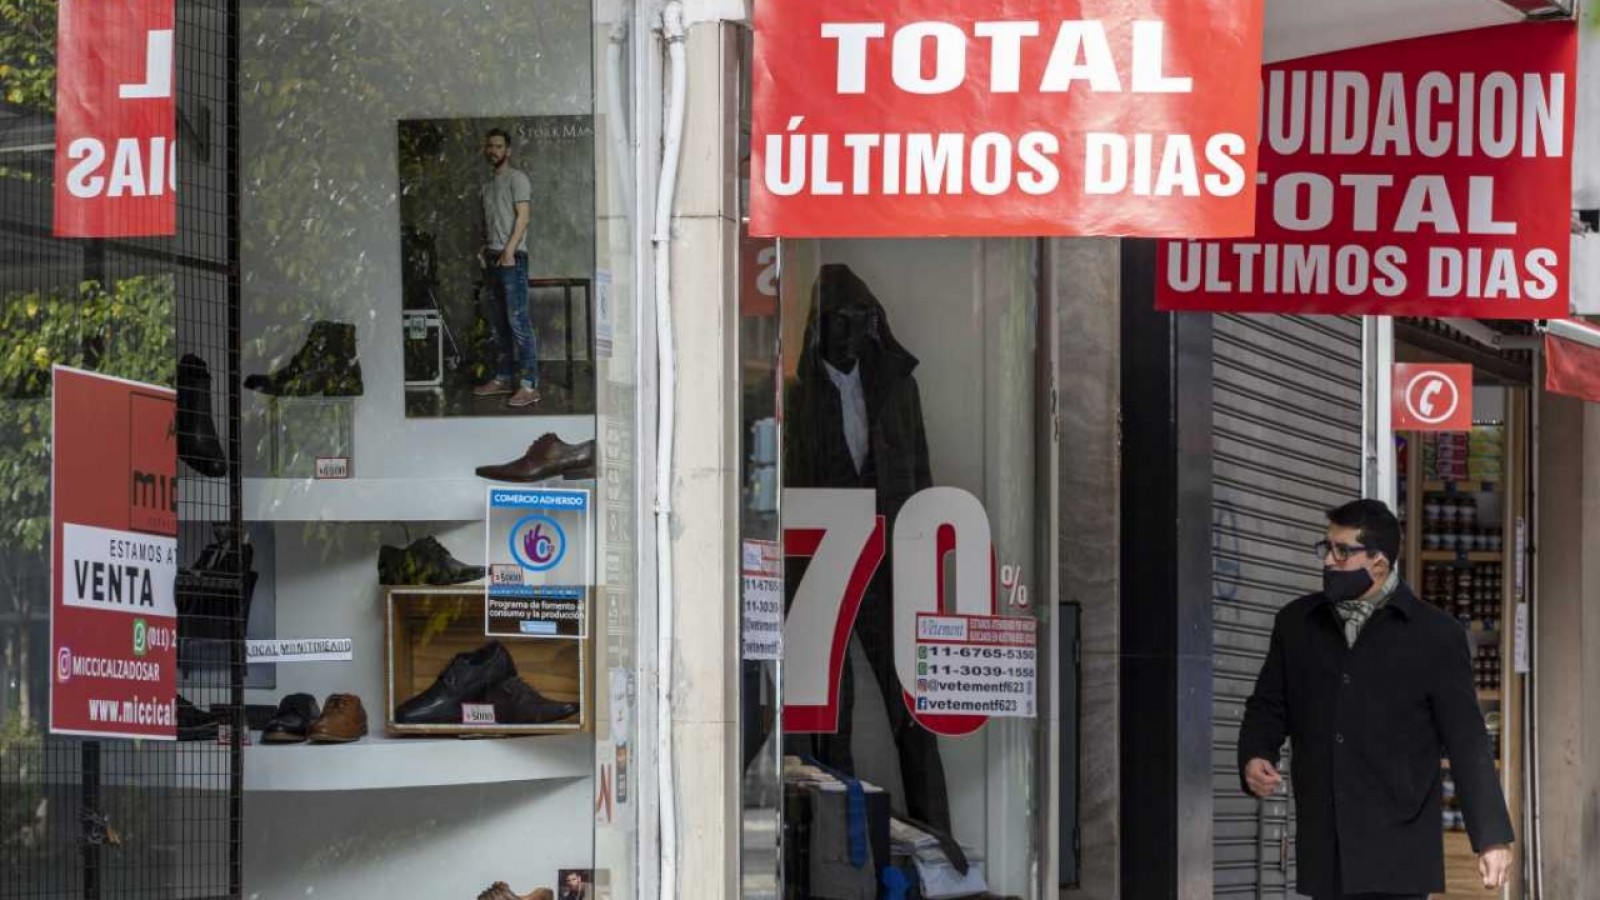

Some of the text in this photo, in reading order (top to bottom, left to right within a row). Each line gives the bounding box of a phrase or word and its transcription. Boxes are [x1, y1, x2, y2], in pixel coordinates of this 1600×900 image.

[820, 20, 1193, 95] TOTAL
[1260, 70, 1565, 159] UIDACION
[764, 115, 1246, 198] ÚLTIMOS DIAS
[1427, 247, 1559, 300] DIAS
[494, 493, 584, 506] COMERCIO ADHERIDO
[110, 539, 162, 564] ESTAMOS
[74, 559, 154, 607] VENTA
[489, 600, 528, 611] Programa
[530, 602, 540, 610] de
[541, 602, 576, 611] fomento
[489, 610, 585, 621] consumo y la producción
[147, 627, 170, 651] (011)
[73, 655, 160, 682] MICCICALZADOSAR
